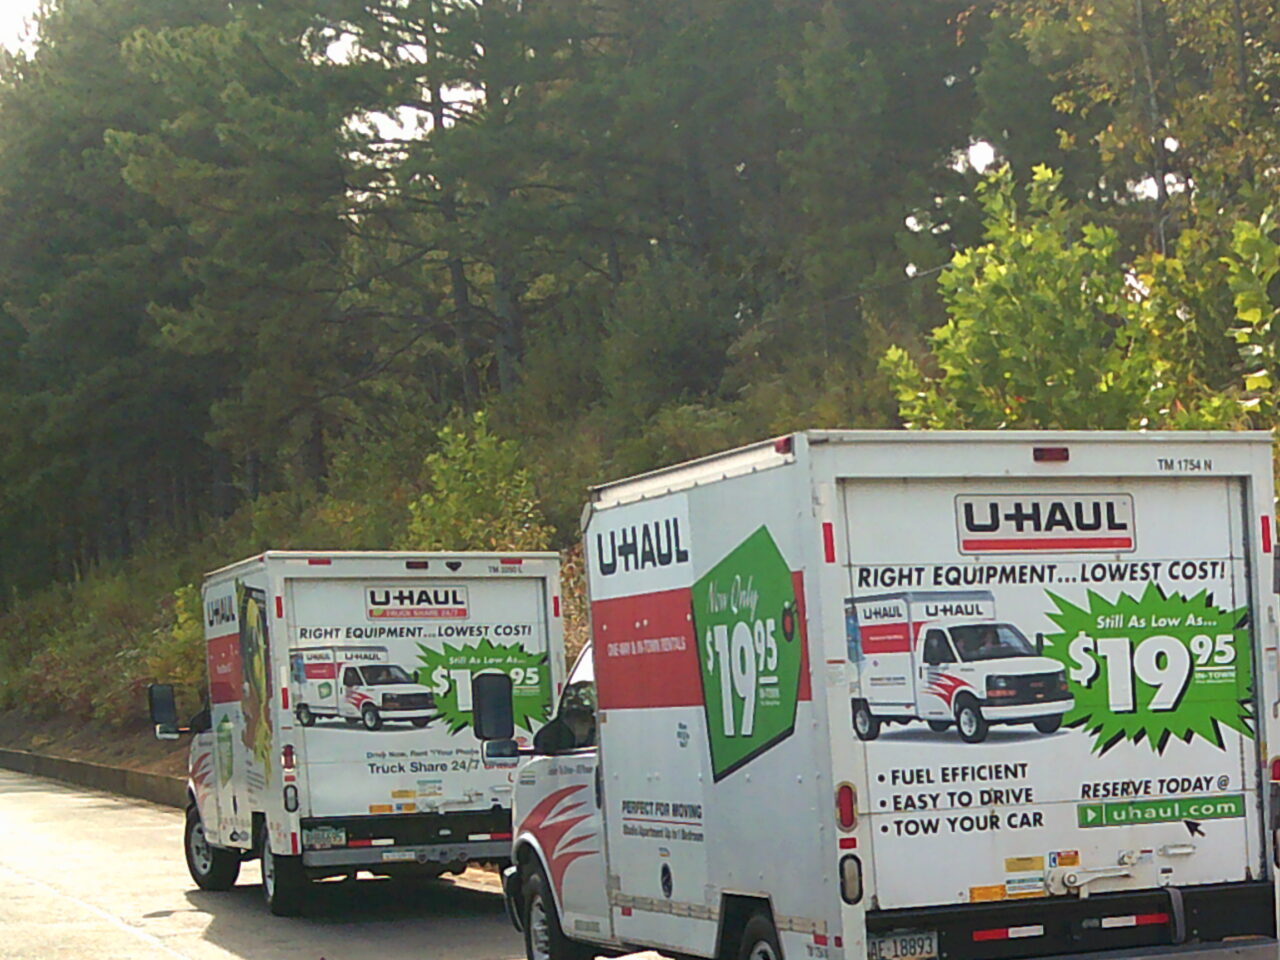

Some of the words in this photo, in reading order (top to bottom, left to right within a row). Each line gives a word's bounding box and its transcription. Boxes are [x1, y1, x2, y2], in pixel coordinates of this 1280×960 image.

[1157, 458, 1174, 471] TM
[1177, 459, 1201, 471] 1754
[1204, 459, 1213, 471] N
[963, 501, 1128, 533] U-HAUL
[597, 517, 689, 576] U-HAUL
[857, 566, 925, 587] RIGHT
[1167, 561, 1226, 580] COST!
[370, 590, 465, 606] U-HAUL
[863, 606, 902, 620] U-HAUL
[925, 604, 983, 617] U-HAUL
[1096, 614, 1123, 629] Still
[1128, 614, 1147, 628] As
[1151, 614, 1183, 628] Low
[299, 627, 341, 639] RIGHT
[494, 625, 532, 637] COST!
[368, 762, 406, 774] Truck
[410, 761, 448, 773] Share
[451, 758, 480, 773] 24/7
[891, 768, 935, 786] FUEL
[940, 763, 1028, 783] EFFICIENT
[1081, 779, 1152, 799] RESERVE
[1157, 776, 1214, 794] TODAY
[1216, 774, 1230, 791] @
[622, 800, 654, 815] PERFECT
[892, 792, 941, 811] EASY
[946, 791, 973, 807] TO
[979, 787, 1034, 806] DRIVE
[1112, 802, 1236, 821] uhaul.com
[893, 818, 940, 837] TOW
[946, 814, 1000, 833] YOUR
[1006, 812, 1044, 829] CAR
